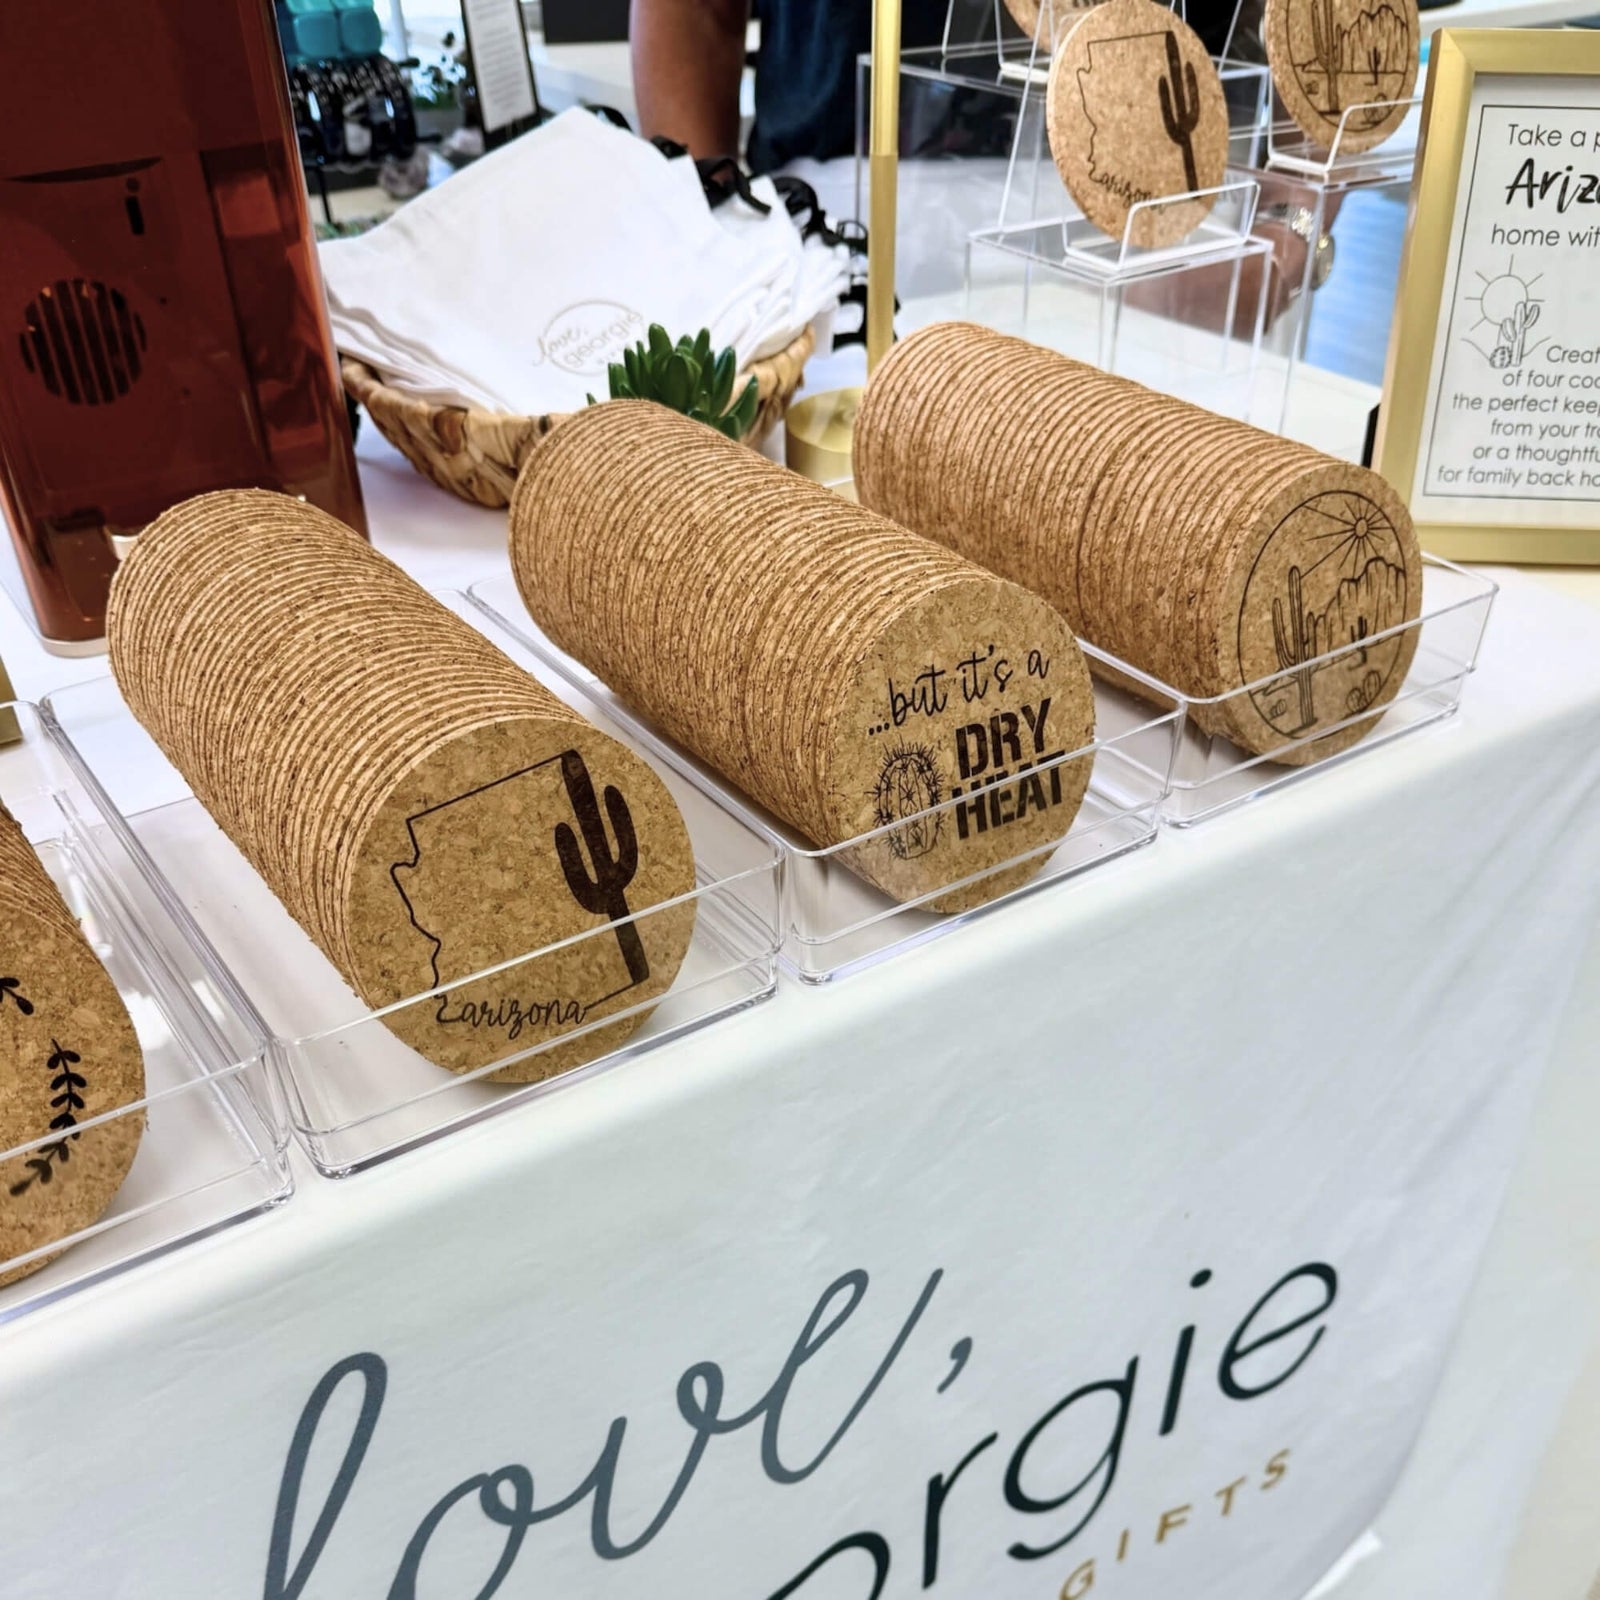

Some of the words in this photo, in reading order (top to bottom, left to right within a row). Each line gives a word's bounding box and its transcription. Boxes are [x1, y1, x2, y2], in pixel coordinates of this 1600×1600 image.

[1508, 124, 1562, 147] Take
[1570, 131, 1586, 147] a
[1505, 157, 1600, 214] Ariz
[1491, 223, 1560, 246] home
[1503, 370, 1523, 387] of
[1527, 370, 1564, 388] four
[1452, 393, 1482, 410] the
[1488, 395, 1558, 414] perfect
[1563, 397, 1600, 418] kee
[1491, 419, 1533, 437] from
[1539, 423, 1580, 440] your
[1473, 446, 1492, 459] or
[1497, 446, 1509, 460] a
[1437, 465, 1463, 483] for
[1467, 466, 1521, 488] family
[1526, 468, 1574, 487] back
[868, 663, 948, 736] ...but
[956, 644, 1014, 703] it's
[1027, 649, 1050, 679] a
[955, 696, 1052, 780] DRY
[951, 749, 1066, 841] HEAT
[460, 998, 588, 1040] arizona
[1058, 1448, 1291, 1600] GIFTS
